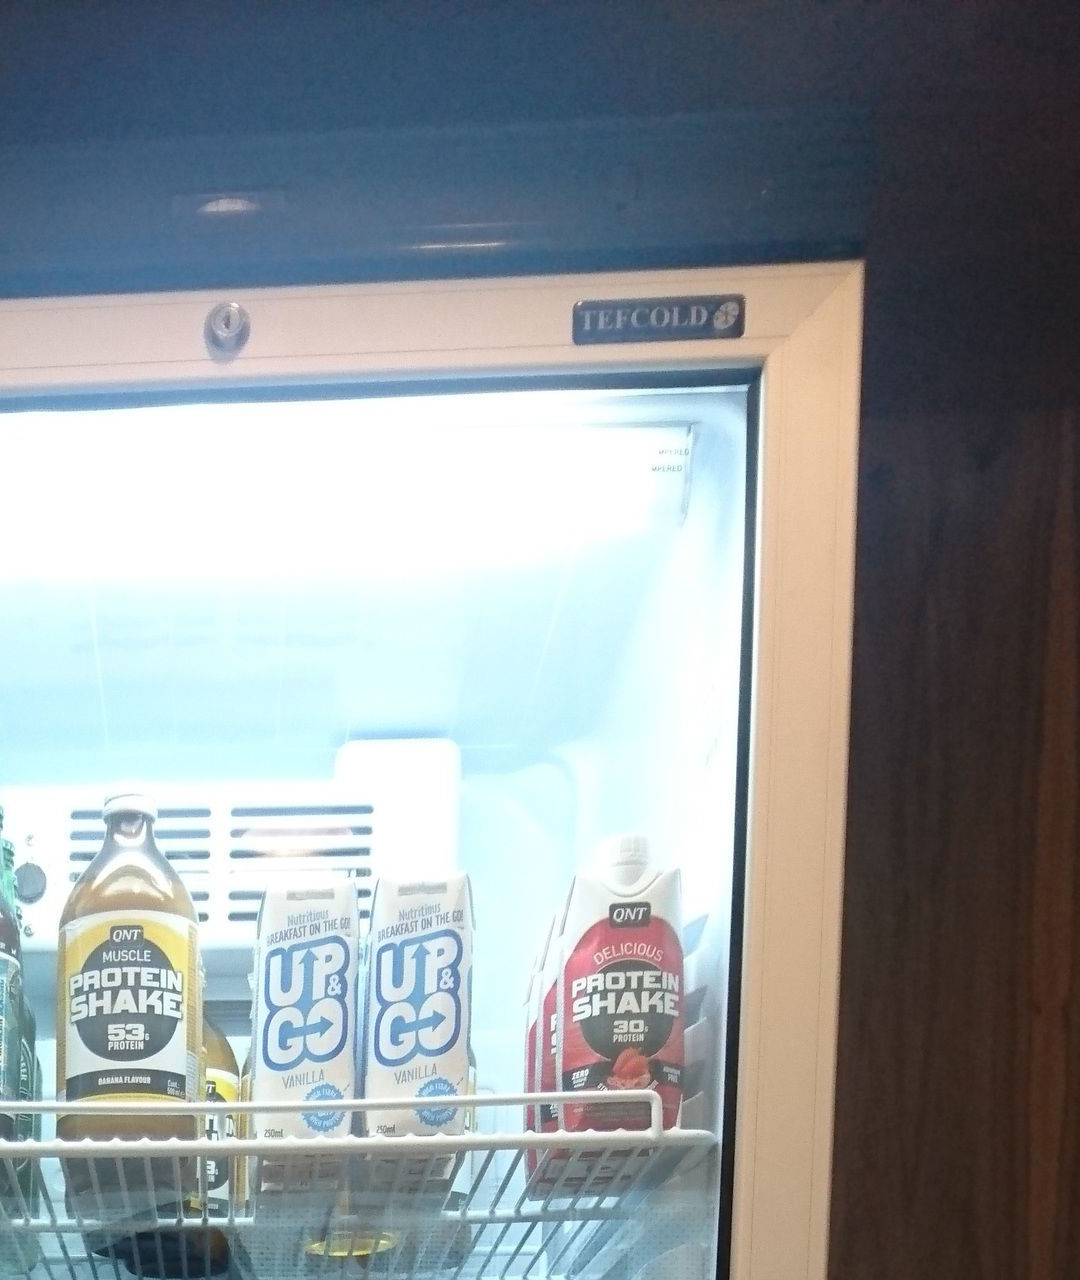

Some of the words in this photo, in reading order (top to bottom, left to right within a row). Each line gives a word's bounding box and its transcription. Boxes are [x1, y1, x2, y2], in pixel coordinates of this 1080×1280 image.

[580, 305, 708, 330] TEFCOLD
[378, 918, 420, 940] BREAKFAST
[420, 916, 433, 930] ON
[434, 913, 450, 926] THE
[612, 906, 647, 923] QNT
[112, 929, 141, 944] QNT
[267, 925, 308, 946] BREAKFAST
[309, 922, 322, 936] ON
[322, 919, 338, 932] THE
[102, 950, 151, 963] MUSCLE
[593, 942, 664, 966] DELICIOUS
[70, 967, 182, 998] PROTEIN
[268, 943, 345, 1007] UP
[327, 974, 342, 996] &
[380, 938, 458, 1003] UP
[439, 967, 455, 990] &
[571, 970, 679, 999] PROTEIN
[71, 989, 182, 1024] SHAKE
[572, 990, 679, 1023] SHAKE
[267, 997, 344, 1064] GO
[379, 992, 456, 1060] GO
[613, 1033, 645, 1043] PROTEIN
[108, 1040, 144, 1051] PROTEIN
[98, 1076, 123, 1086] BANANA
[123, 1076, 151, 1085] FLAVOUR
[281, 1069, 325, 1089] VANILLA
[394, 1063, 438, 1085] VANILLA
[571, 1068, 589, 1080] ZERO
[264, 1128, 284, 1138] 250ml
[376, 1124, 396, 1135] 250ml
